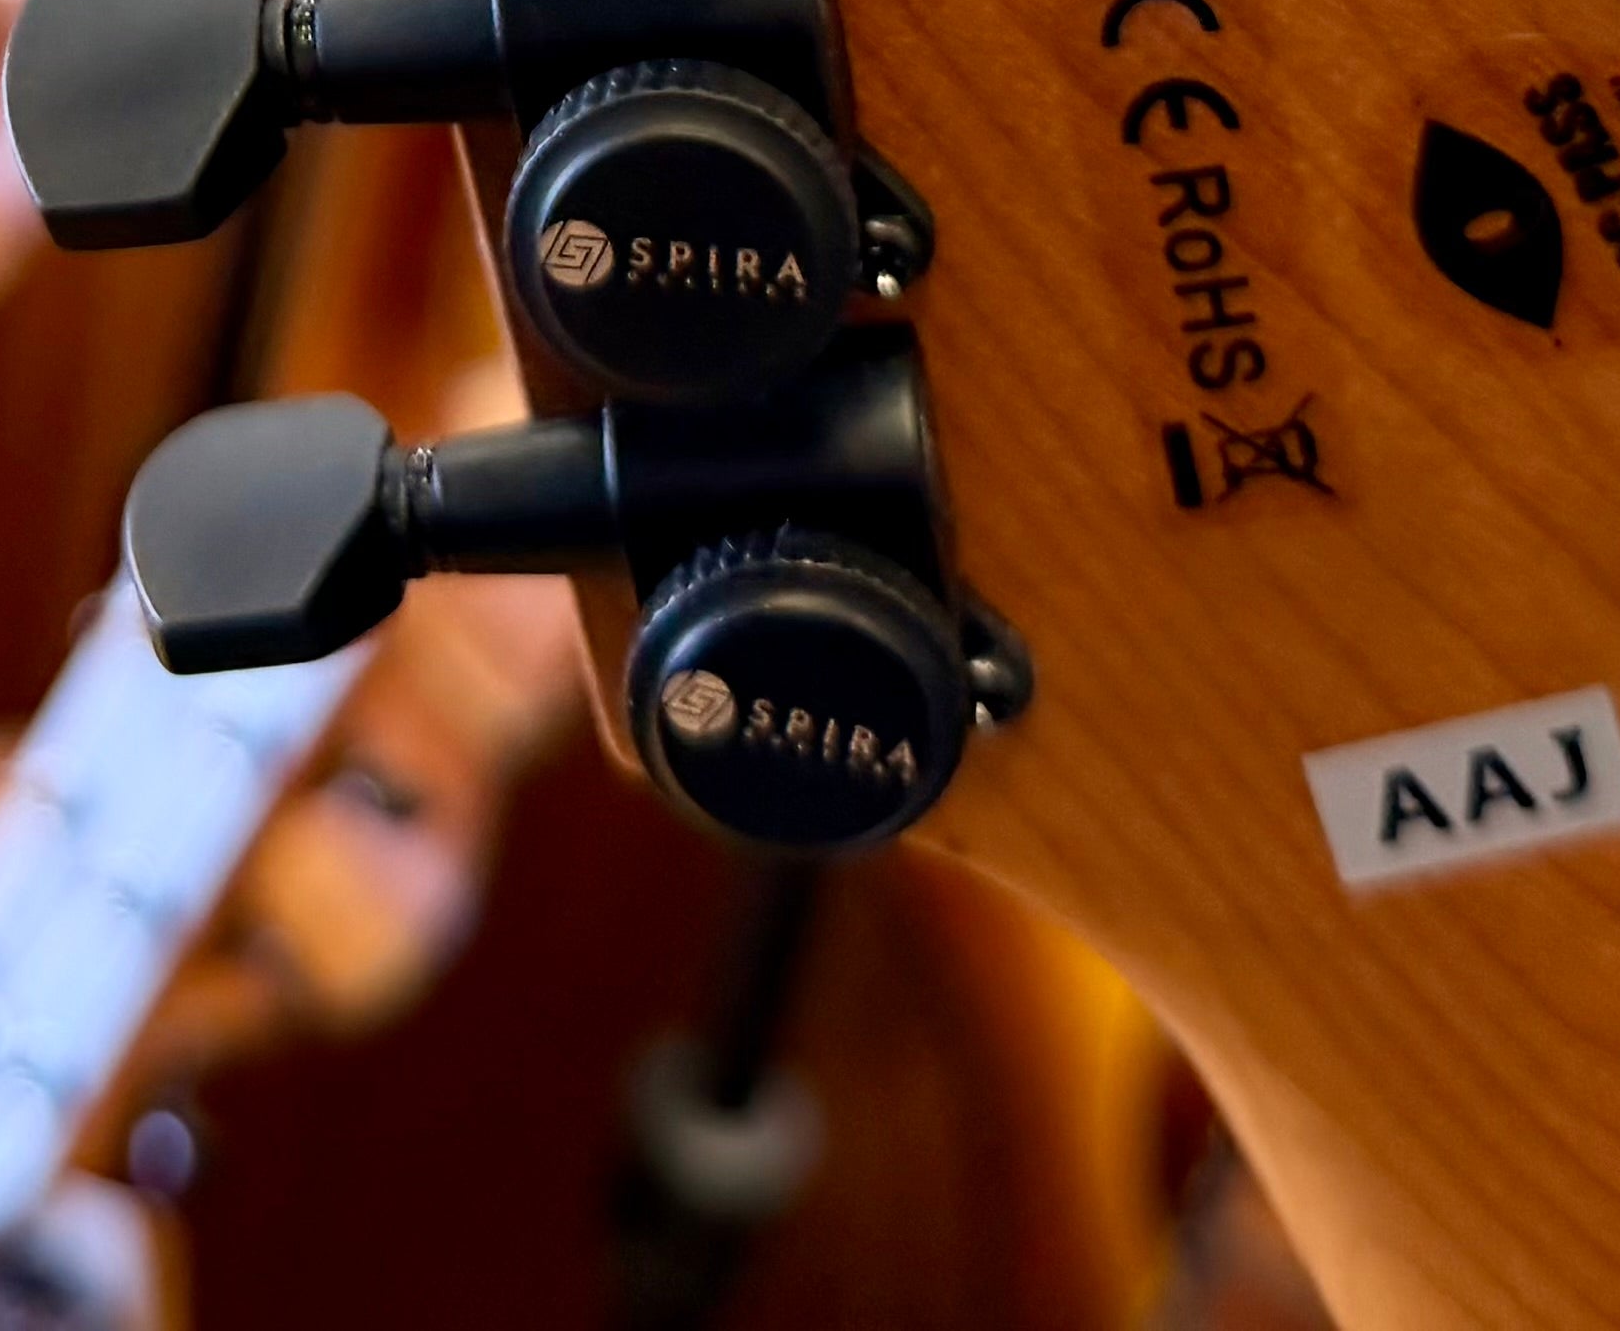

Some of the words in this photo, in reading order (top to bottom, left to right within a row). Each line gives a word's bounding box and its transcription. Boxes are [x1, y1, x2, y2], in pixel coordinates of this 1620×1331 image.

[628, 236, 807, 287] SPIRA
[1148, 163, 1267, 392] RoHS
[748, 697, 917, 785] SPIRA
[1380, 724, 1589, 843] AAJ
